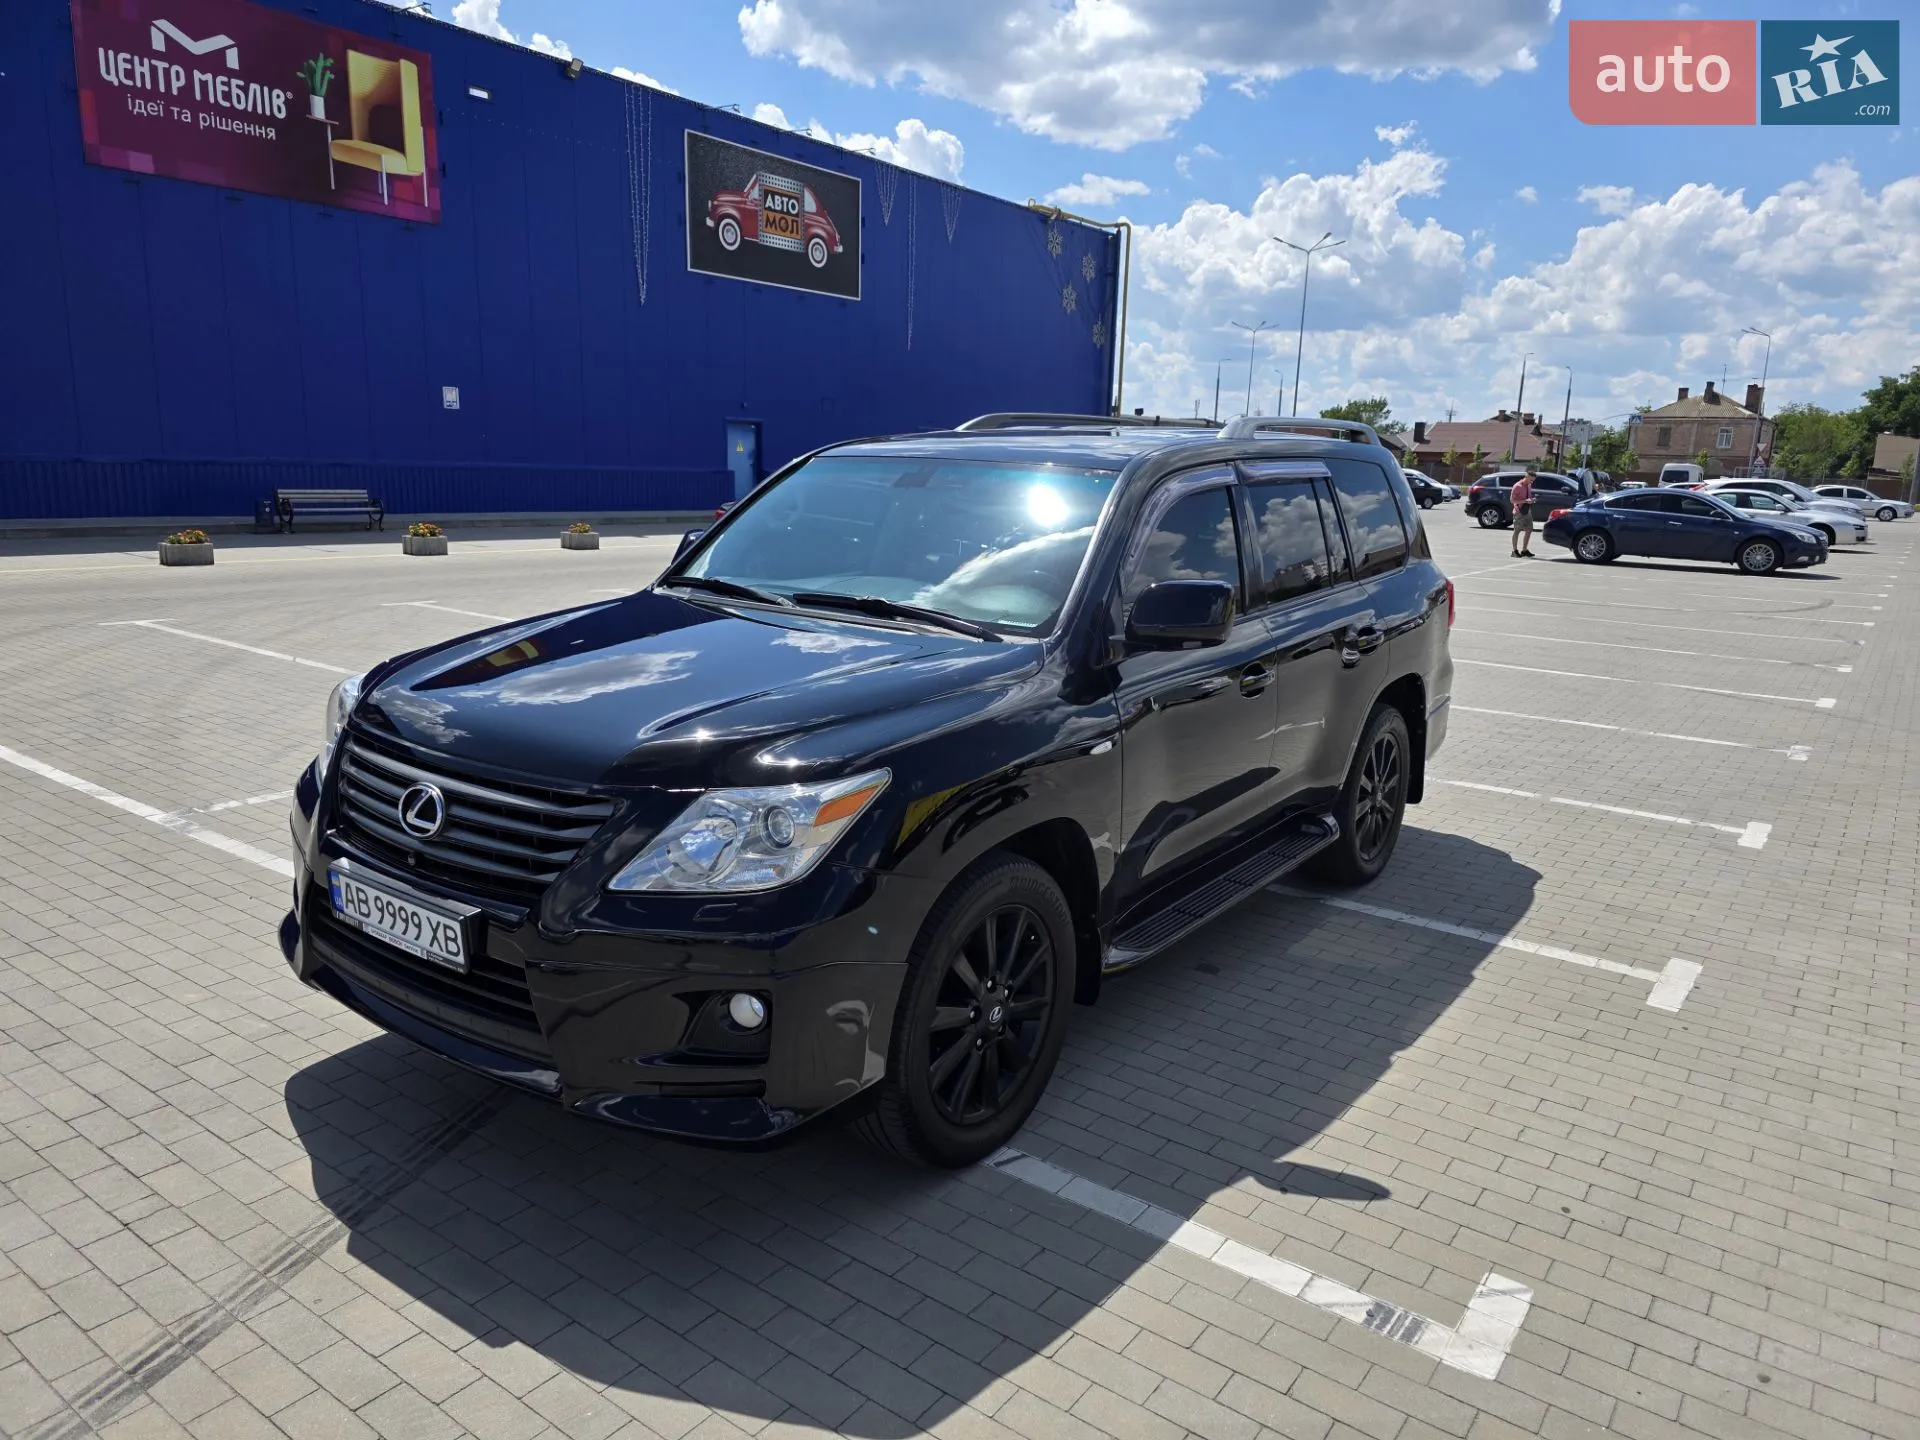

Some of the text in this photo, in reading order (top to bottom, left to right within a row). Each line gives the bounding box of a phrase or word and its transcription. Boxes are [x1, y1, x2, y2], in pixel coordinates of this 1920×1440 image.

[98, 47, 186, 96] ЦЕНТР
[127, 94, 277, 141] ідеї та рішення
[765, 193, 799, 214] АВТО
[765, 214, 799, 235] МОЛ
[345, 881, 372, 919] AB
[373, 895, 423, 942] 9999
[425, 915, 462, 958] XB
